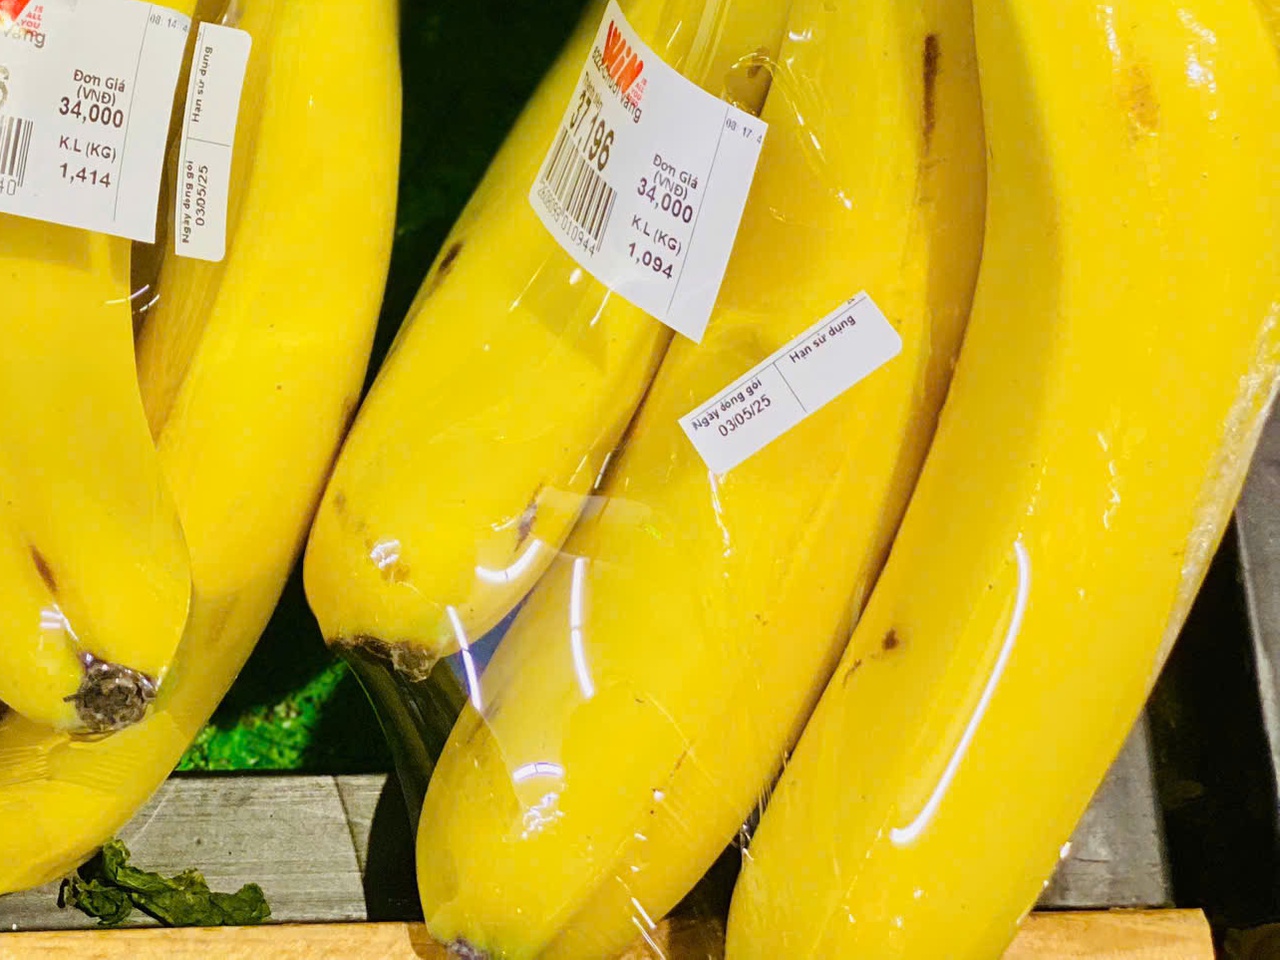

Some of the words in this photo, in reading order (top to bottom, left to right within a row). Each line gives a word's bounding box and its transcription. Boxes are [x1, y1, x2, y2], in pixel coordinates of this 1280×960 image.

[73, 69, 101, 87] Đơn
[105, 76, 126, 93] Giá
[77, 84, 116, 107] (VNĐ)
[191, 98, 203, 123] Hạn
[199, 46, 213, 76] dụng
[59, 96, 124, 128] 34,000
[59, 135, 82, 153] K.L
[85, 141, 117, 164] (KG)
[570, 92, 615, 171] 37,196
[60, 162, 111, 188] 1,414
[653, 153, 676, 177] Đơn
[679, 171, 698, 189] Giá
[653, 170, 688, 201] (VNĐ)
[195, 165, 208, 226] 03/05/25
[637, 177, 693, 223] 34,000
[631, 214, 650, 237] K.L
[653, 228, 682, 256] (KG)
[628, 242, 673, 279] 1,094
[789, 345, 812, 364] Hạn
[828, 315, 856, 337] dụng
[691, 409, 720, 431] Ngày
[718, 394, 772, 437] 03/05/25
